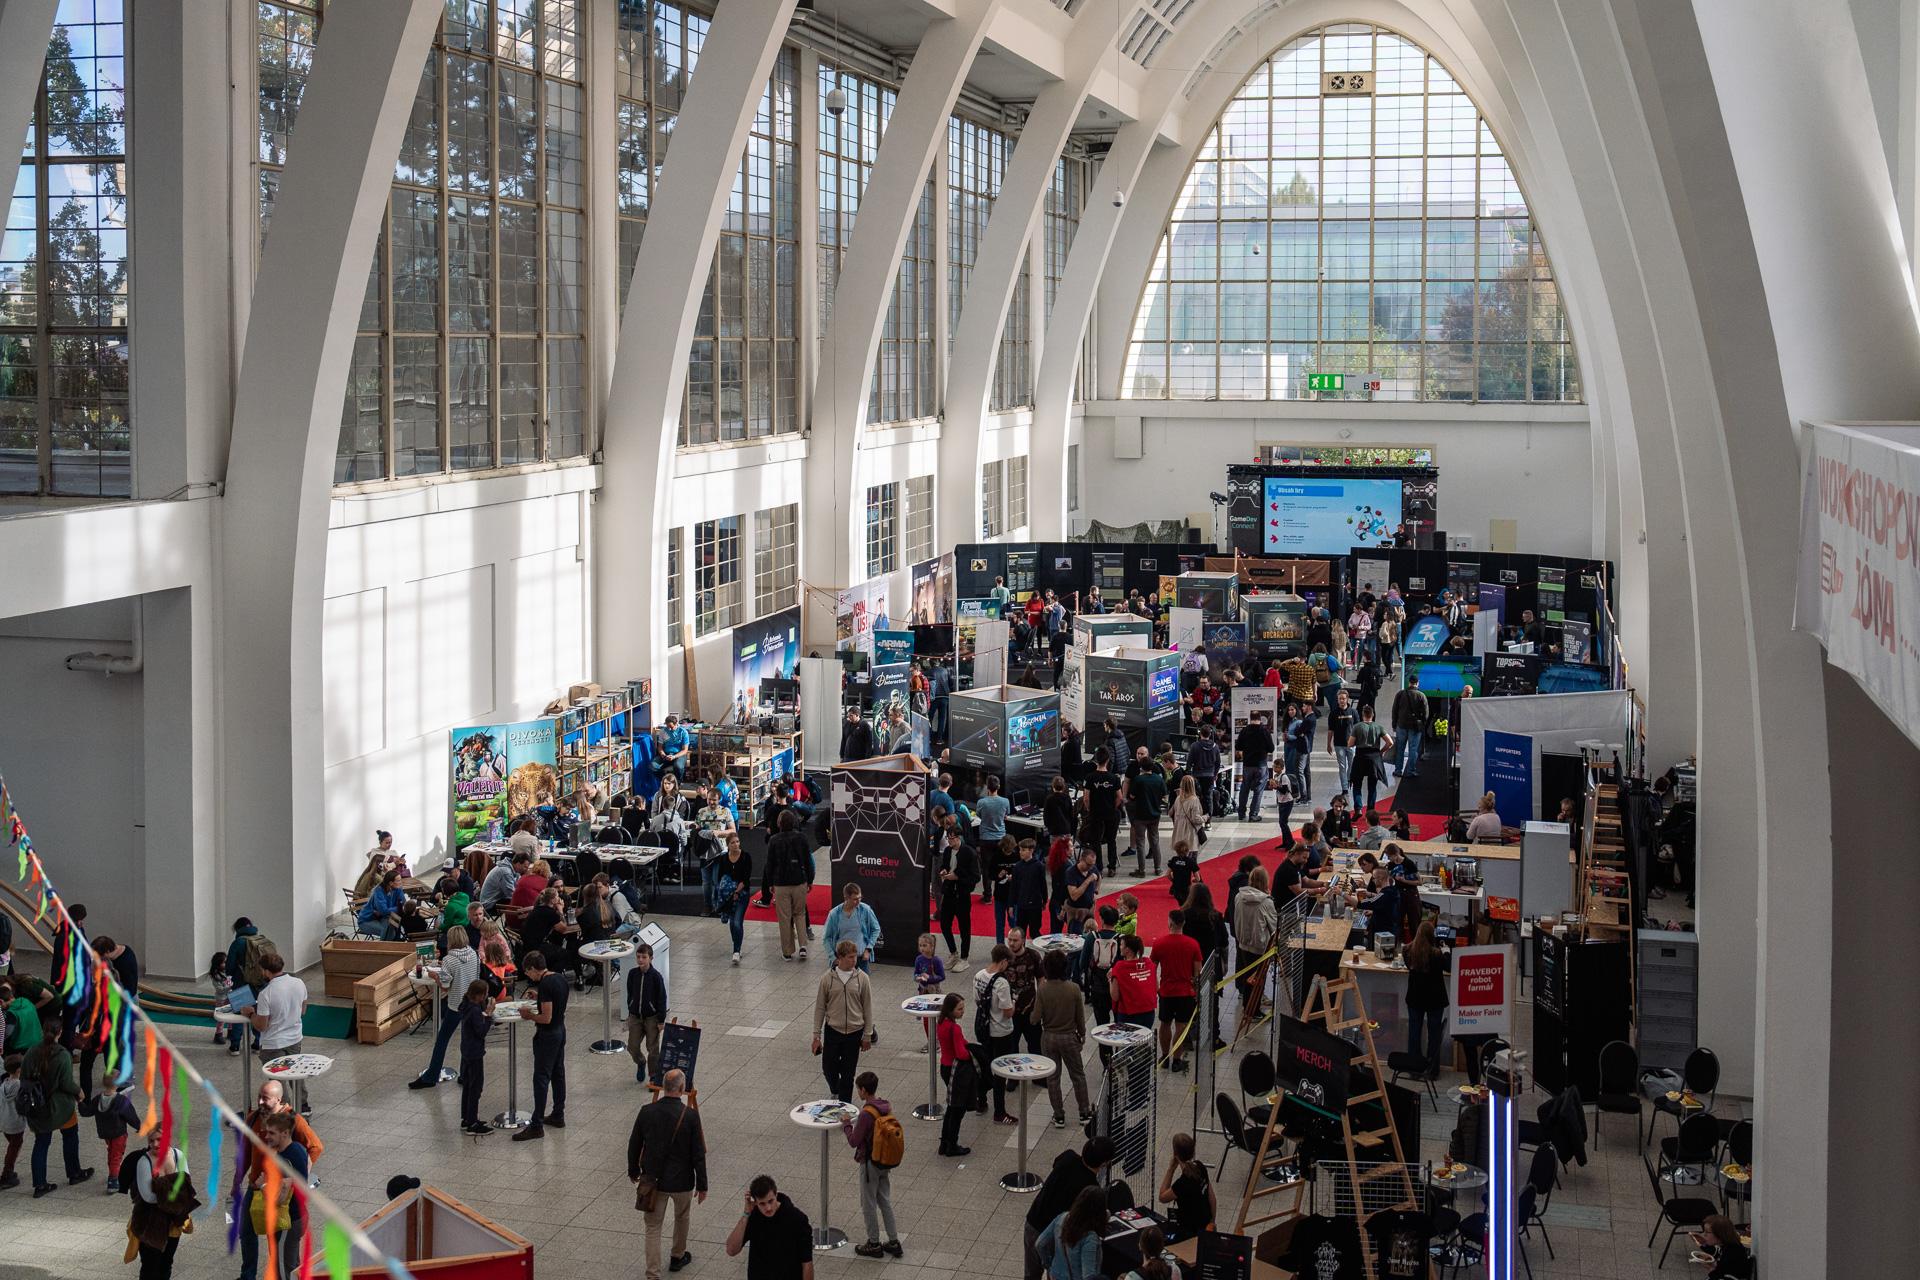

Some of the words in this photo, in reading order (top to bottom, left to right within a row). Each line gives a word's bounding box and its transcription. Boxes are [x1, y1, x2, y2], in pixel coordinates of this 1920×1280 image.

[1819, 455, 1920, 572] WORKSHOPOV
[853, 600, 866, 617] JOIN
[857, 615, 868, 633] US!
[1156, 677, 1172, 687] GAME
[1495, 747, 1522, 755] SUPPORTERS
[856, 854, 900, 867] GameDev
[858, 866, 896, 878] Connect
[1460, 967, 1502, 976] FRAVEBOT
[1468, 983, 1494, 992] farmář
[1458, 1009, 1482, 1017] Maker
[1484, 1008, 1502, 1016] Faire
[1296, 1045, 1333, 1072] MERCH
